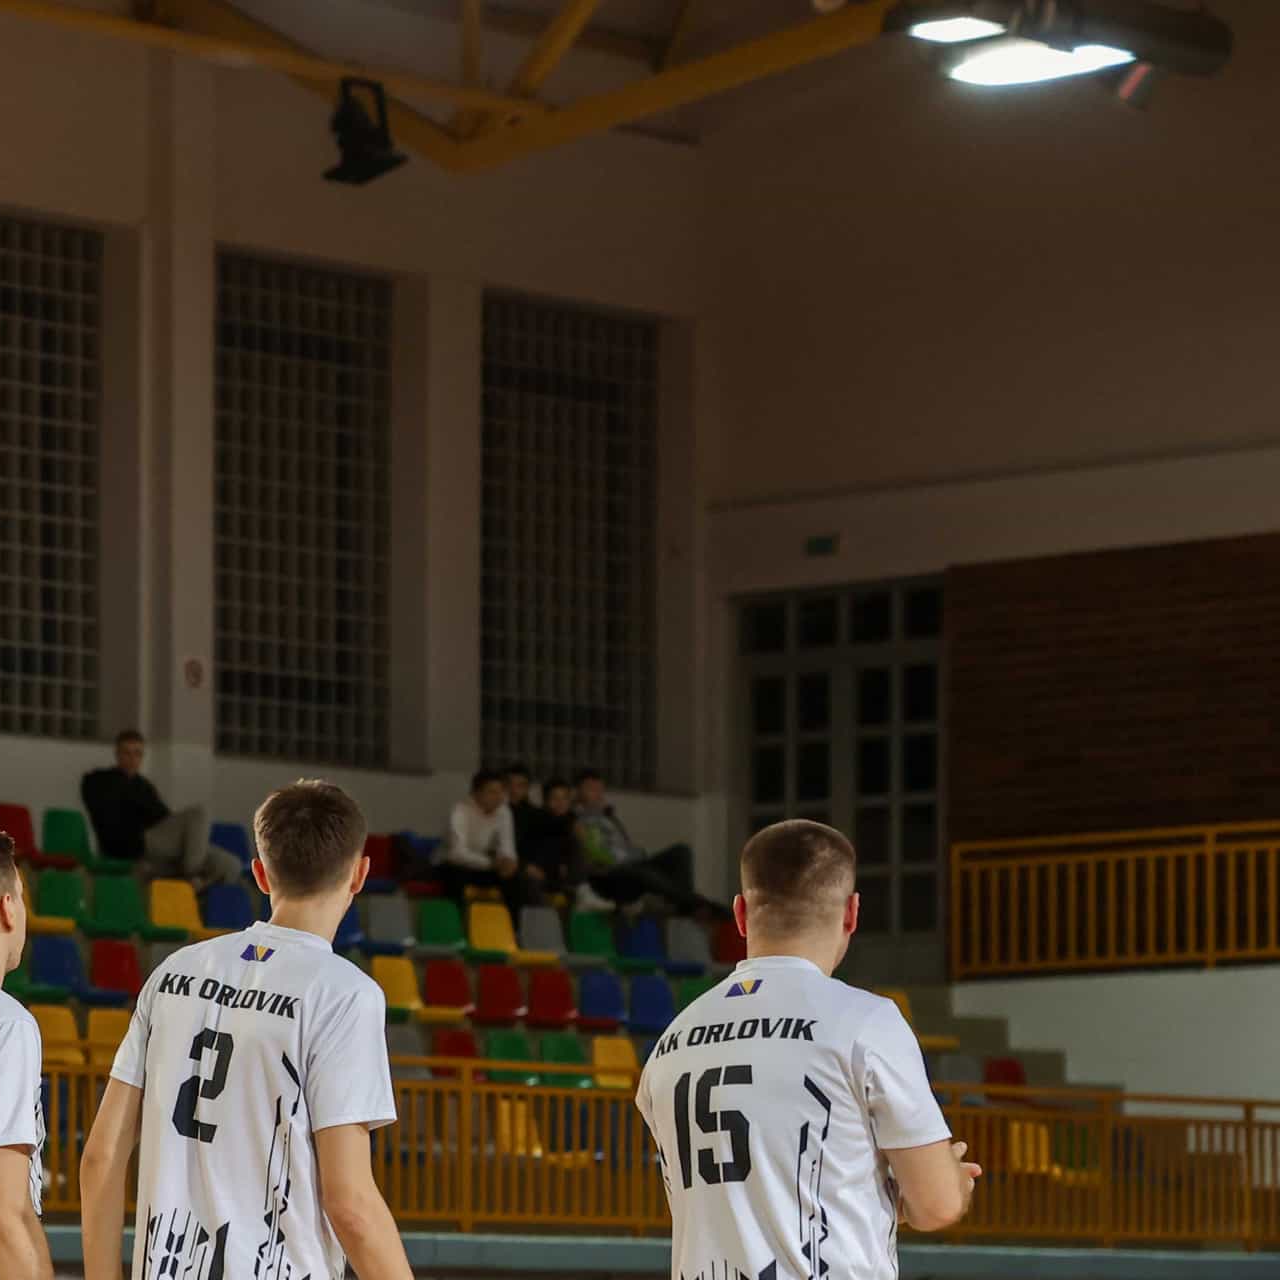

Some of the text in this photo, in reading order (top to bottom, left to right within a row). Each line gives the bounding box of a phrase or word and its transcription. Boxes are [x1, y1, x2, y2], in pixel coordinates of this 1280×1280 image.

[159, 973, 301, 1019] KK ORLOVIK
[687, 1018, 818, 1047] ORLOVIK
[172, 1027, 234, 1143] 2
[674, 1065, 753, 1189] 15
